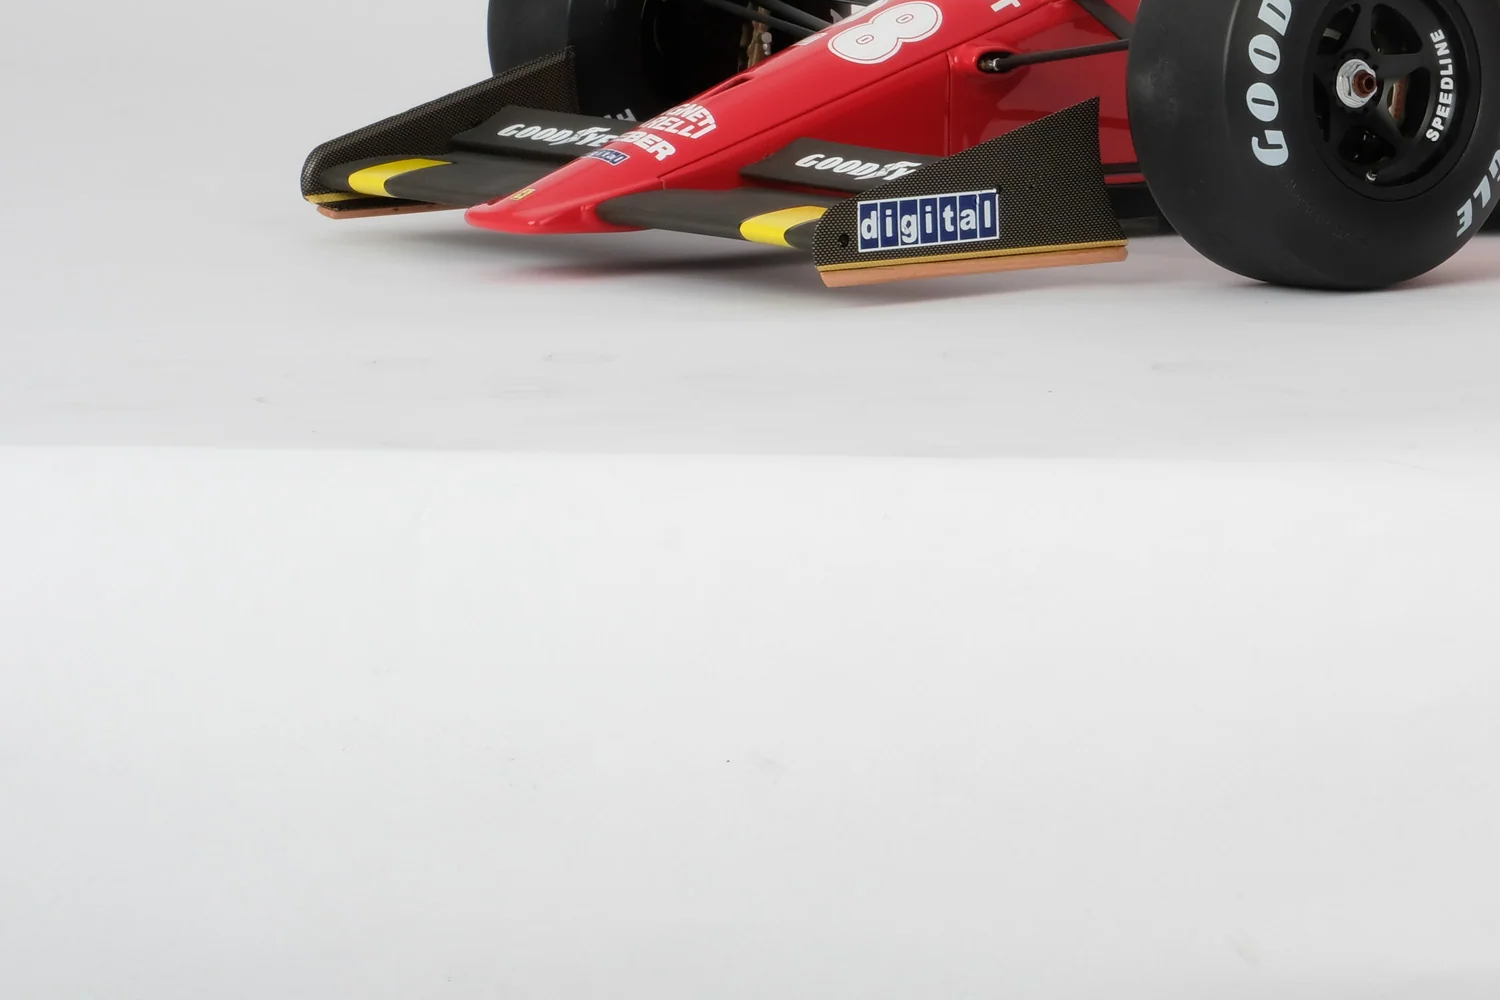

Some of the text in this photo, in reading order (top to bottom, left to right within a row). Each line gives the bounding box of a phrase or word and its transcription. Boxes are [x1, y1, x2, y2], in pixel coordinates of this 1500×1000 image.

[1425, 29, 1454, 142] SPEEDLINE
[795, 153, 921, 180] GOODY
[860, 200, 991, 244] digital
